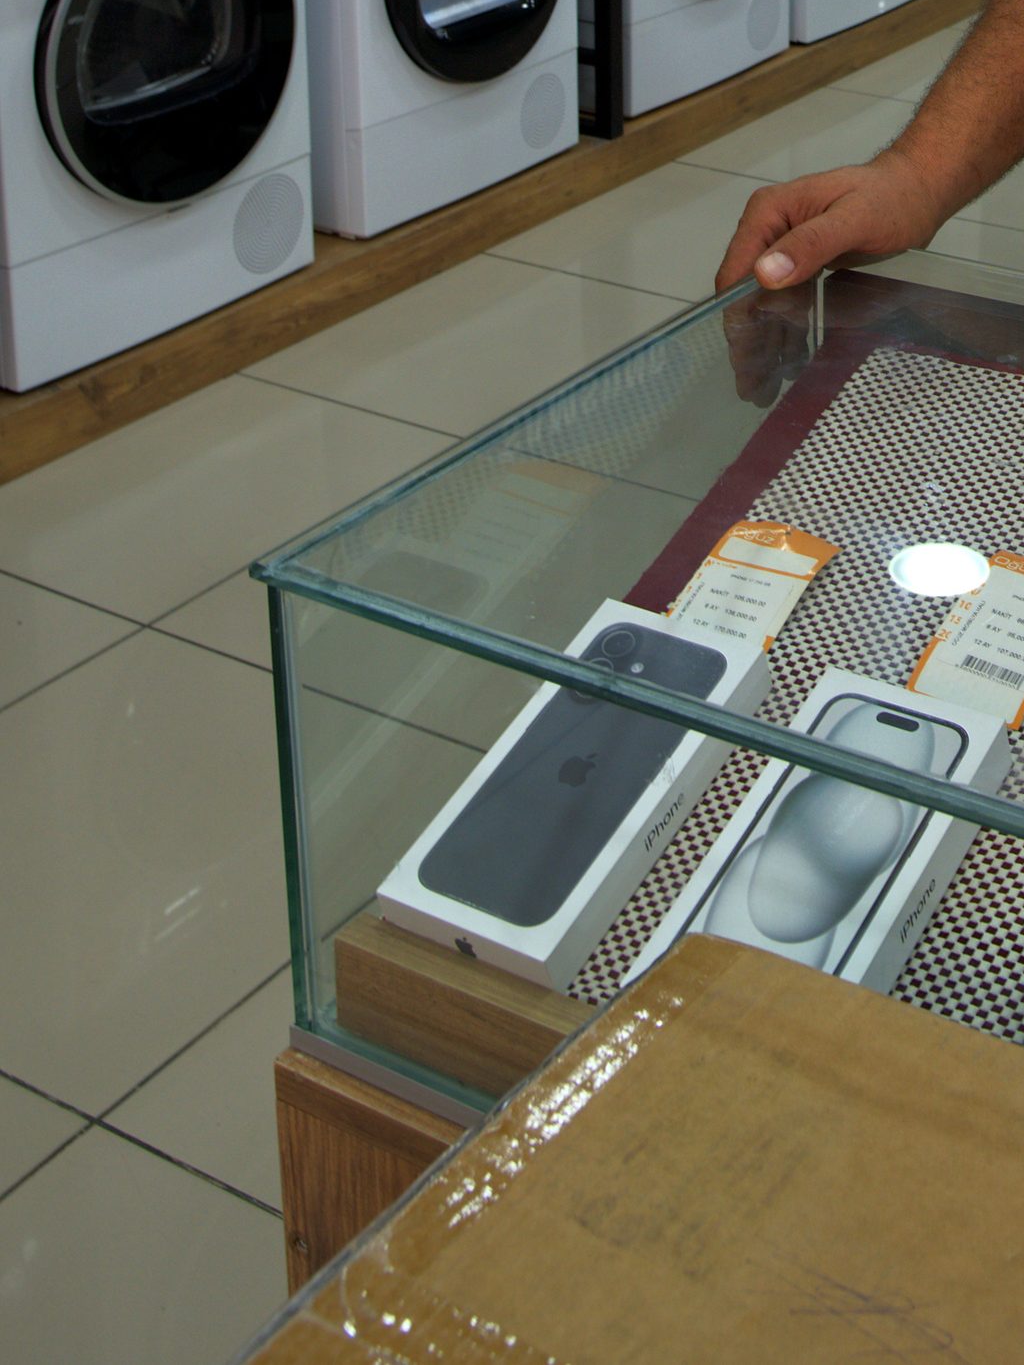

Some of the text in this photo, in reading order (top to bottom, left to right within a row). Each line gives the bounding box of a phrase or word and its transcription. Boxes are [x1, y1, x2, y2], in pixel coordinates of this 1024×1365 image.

[974, 638, 983, 647] 12
[642, 790, 685, 853] iPhone
[899, 878, 937, 945] iPhone
